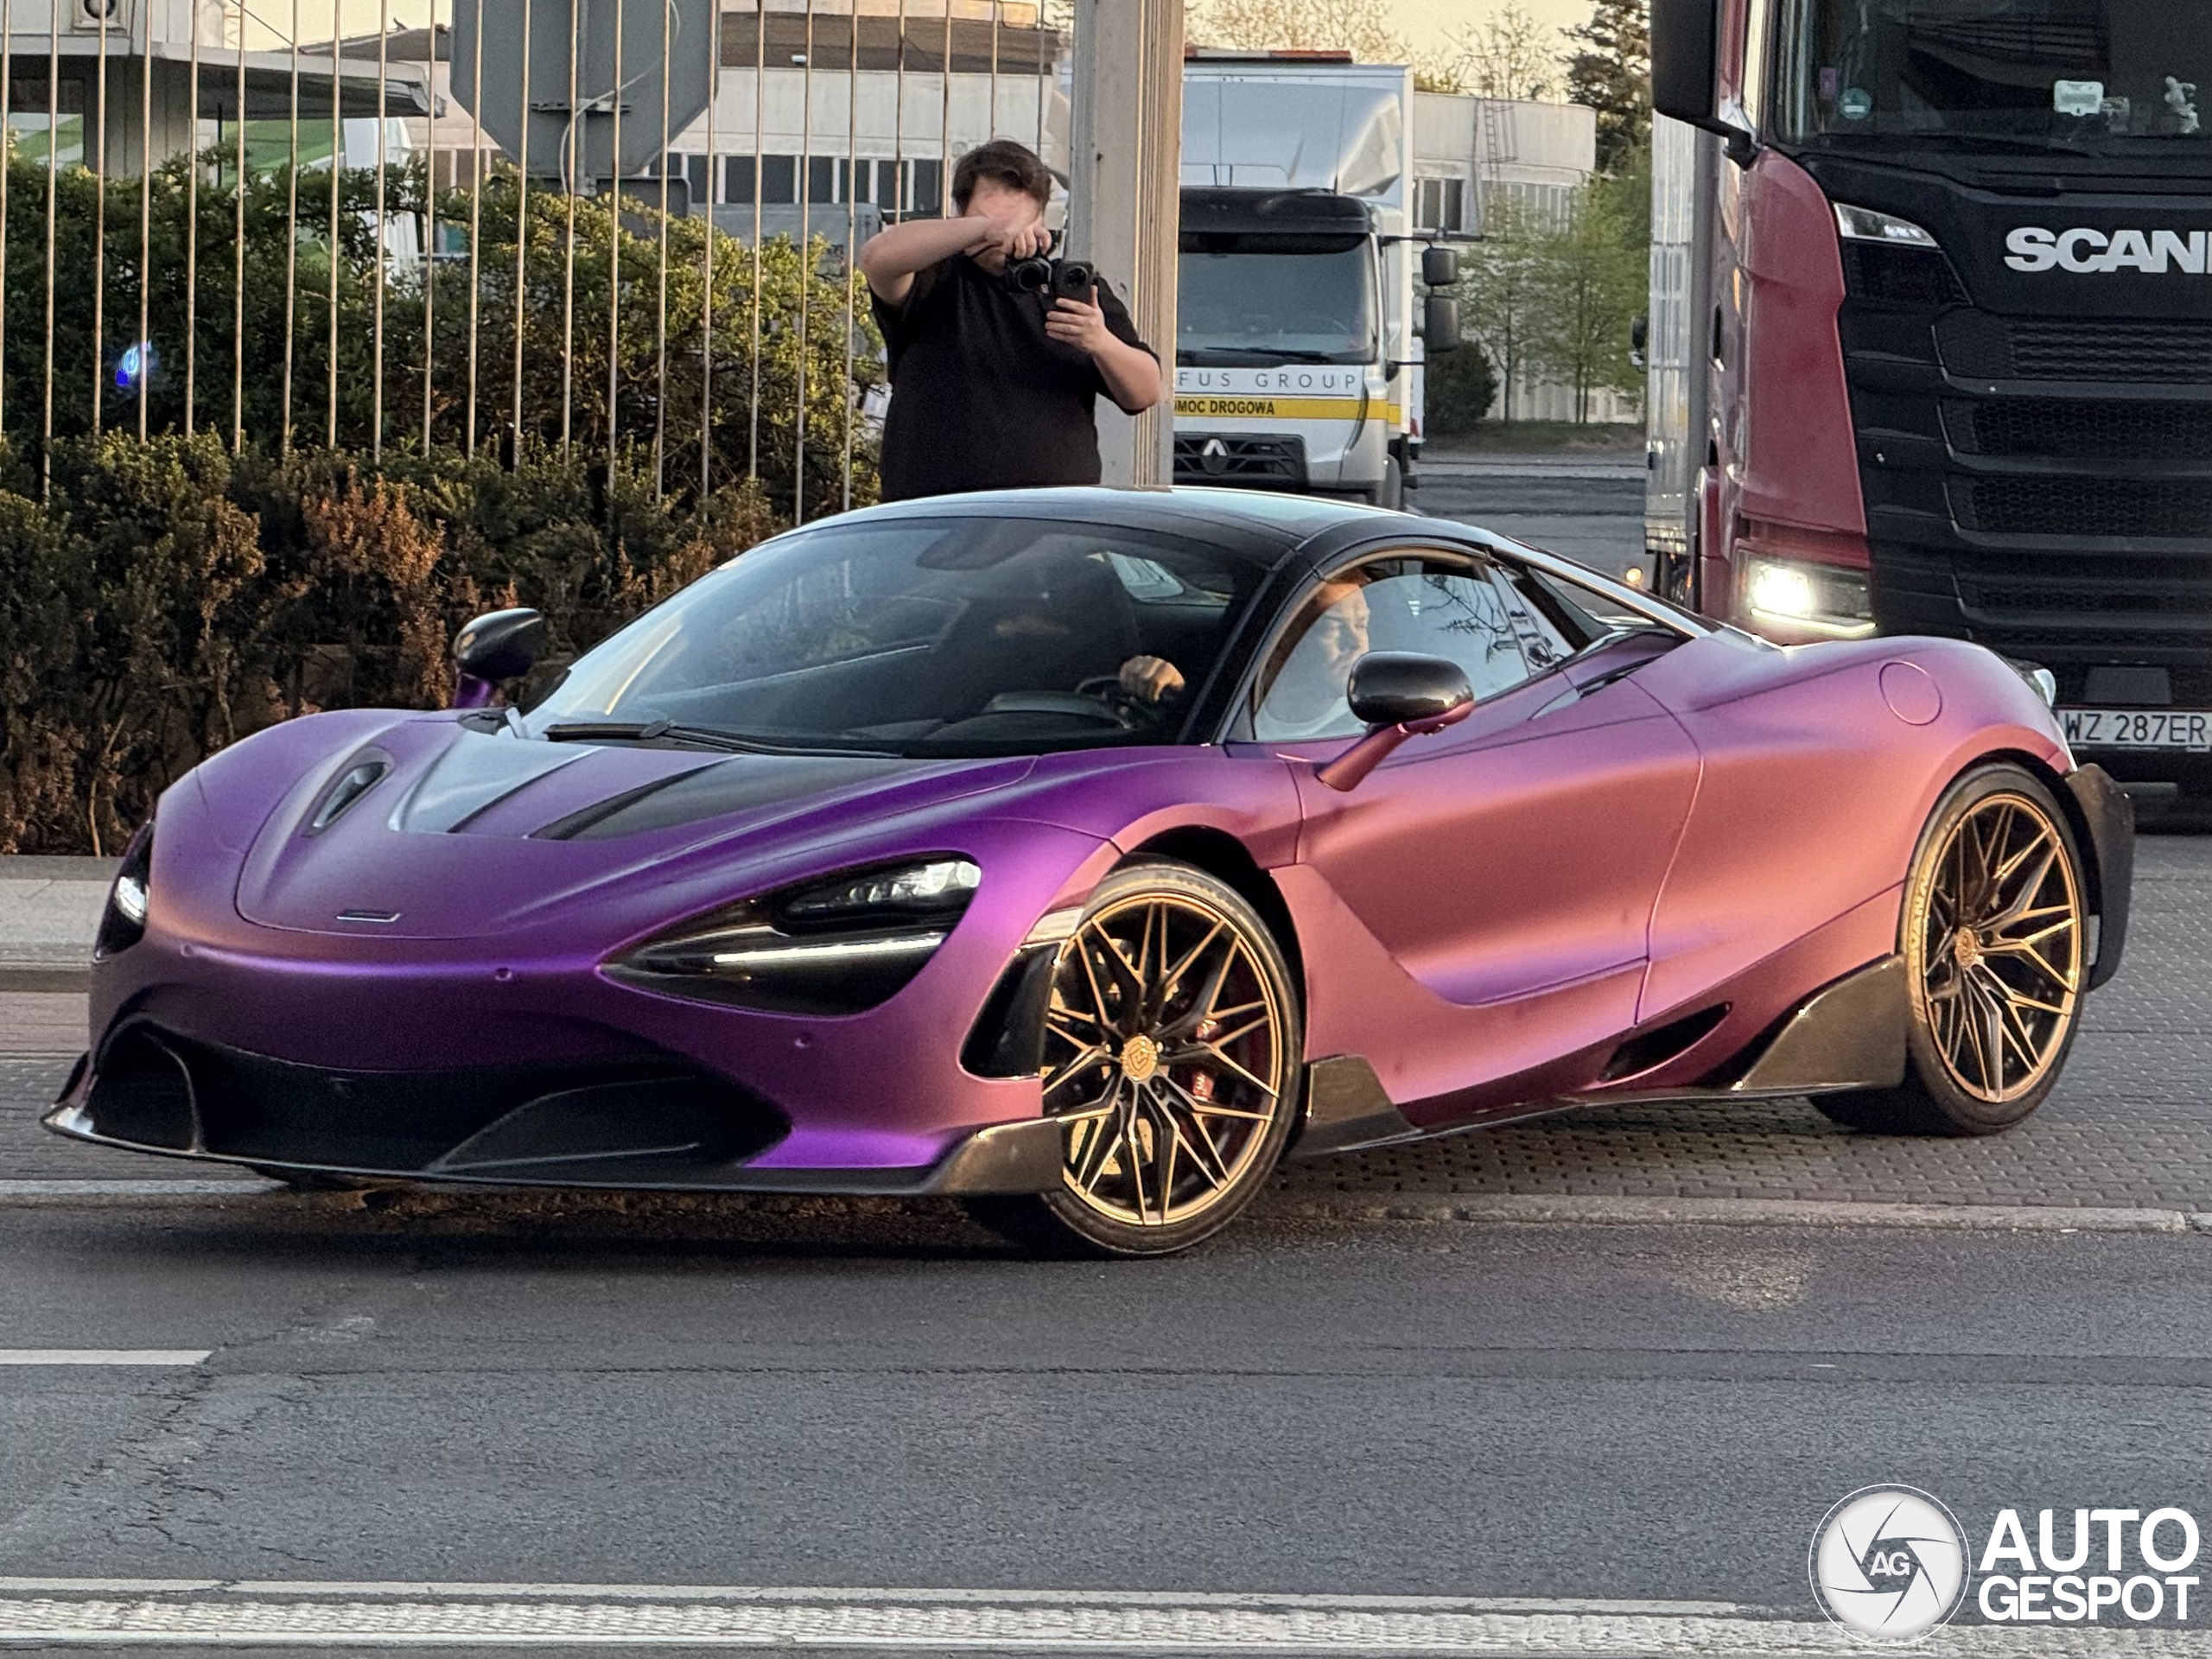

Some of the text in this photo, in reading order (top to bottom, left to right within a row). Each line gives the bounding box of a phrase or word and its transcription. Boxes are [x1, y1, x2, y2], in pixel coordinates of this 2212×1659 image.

[1255, 373, 1356, 389] GROUP
[1210, 400, 1275, 415] DROGOWA
[2065, 713, 2207, 743] WZ 287ER
